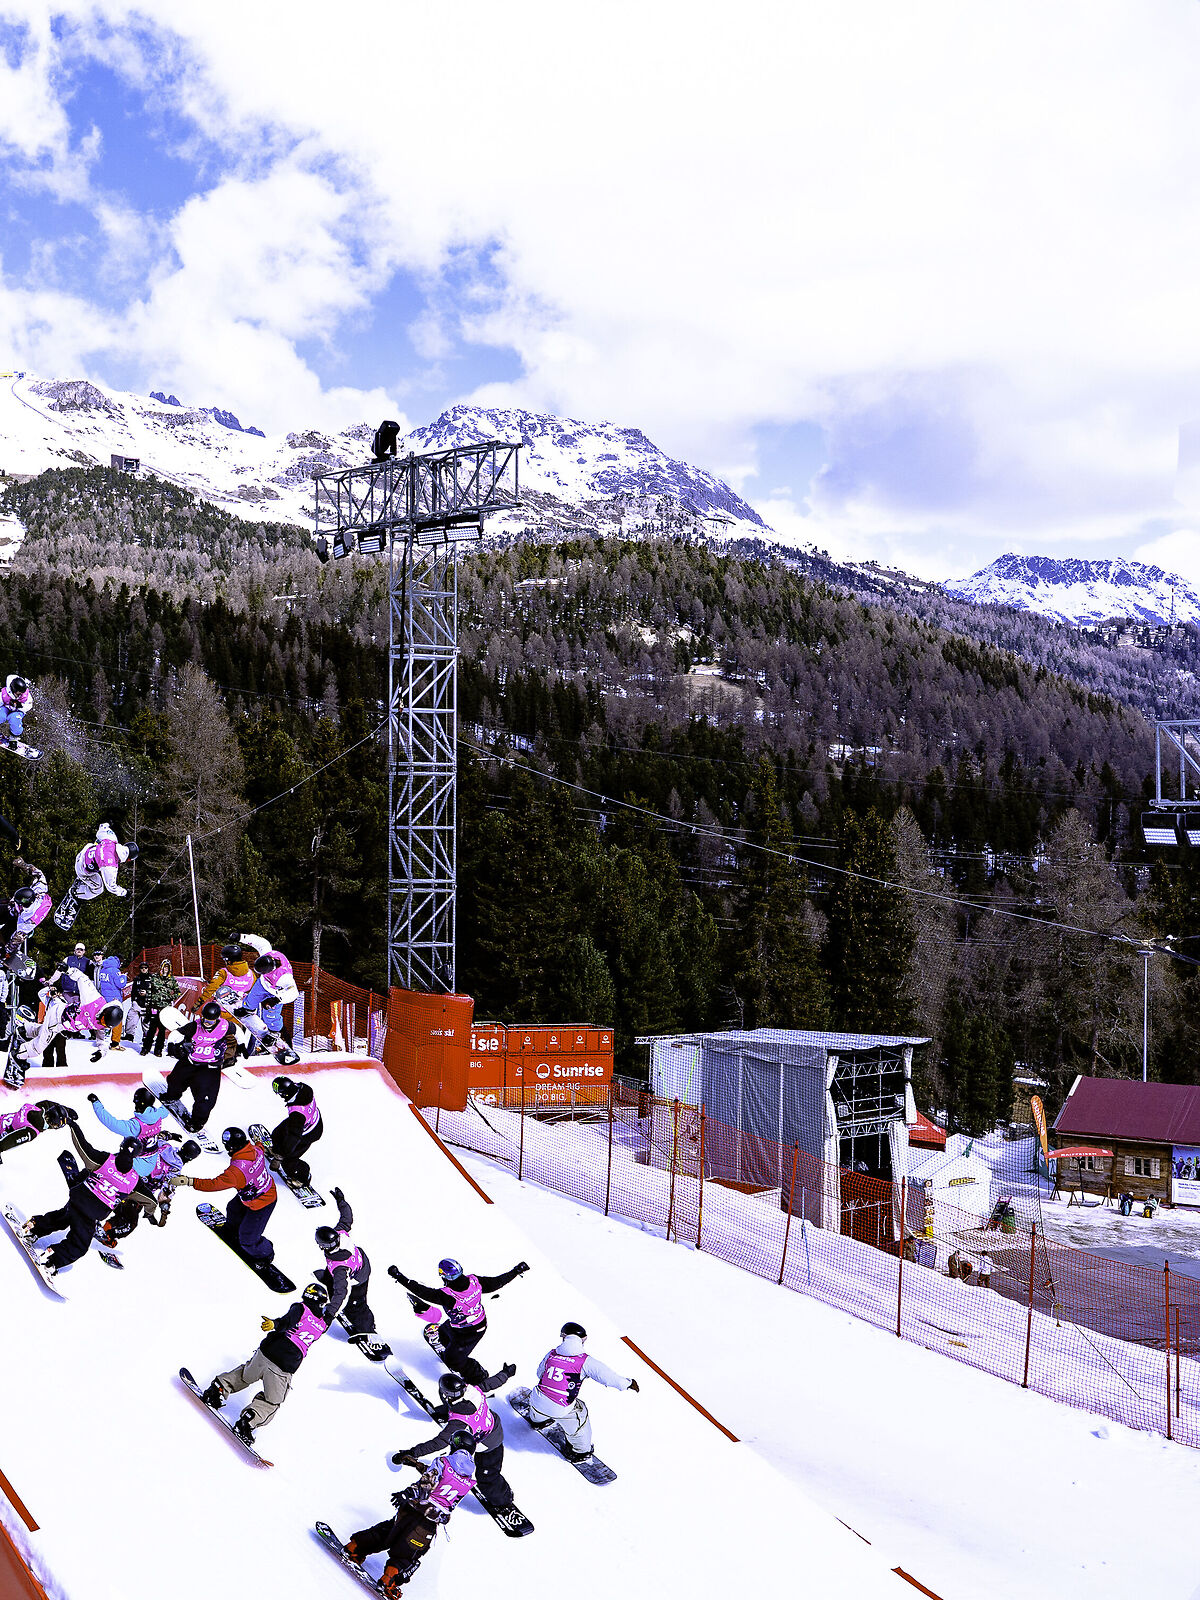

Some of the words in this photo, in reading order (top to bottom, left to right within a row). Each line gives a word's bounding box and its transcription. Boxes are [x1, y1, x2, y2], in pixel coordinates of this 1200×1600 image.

[196, 1046, 213, 1055] 08
[553, 1063, 604, 1078] Sunrise
[535, 1083, 565, 1091] DREAM
[536, 1093, 549, 1101] DO
[551, 1093, 567, 1101] BIG.
[99, 1180, 120, 1197] 35
[547, 1366, 565, 1382] 13
[440, 1485, 459, 1501] 11
